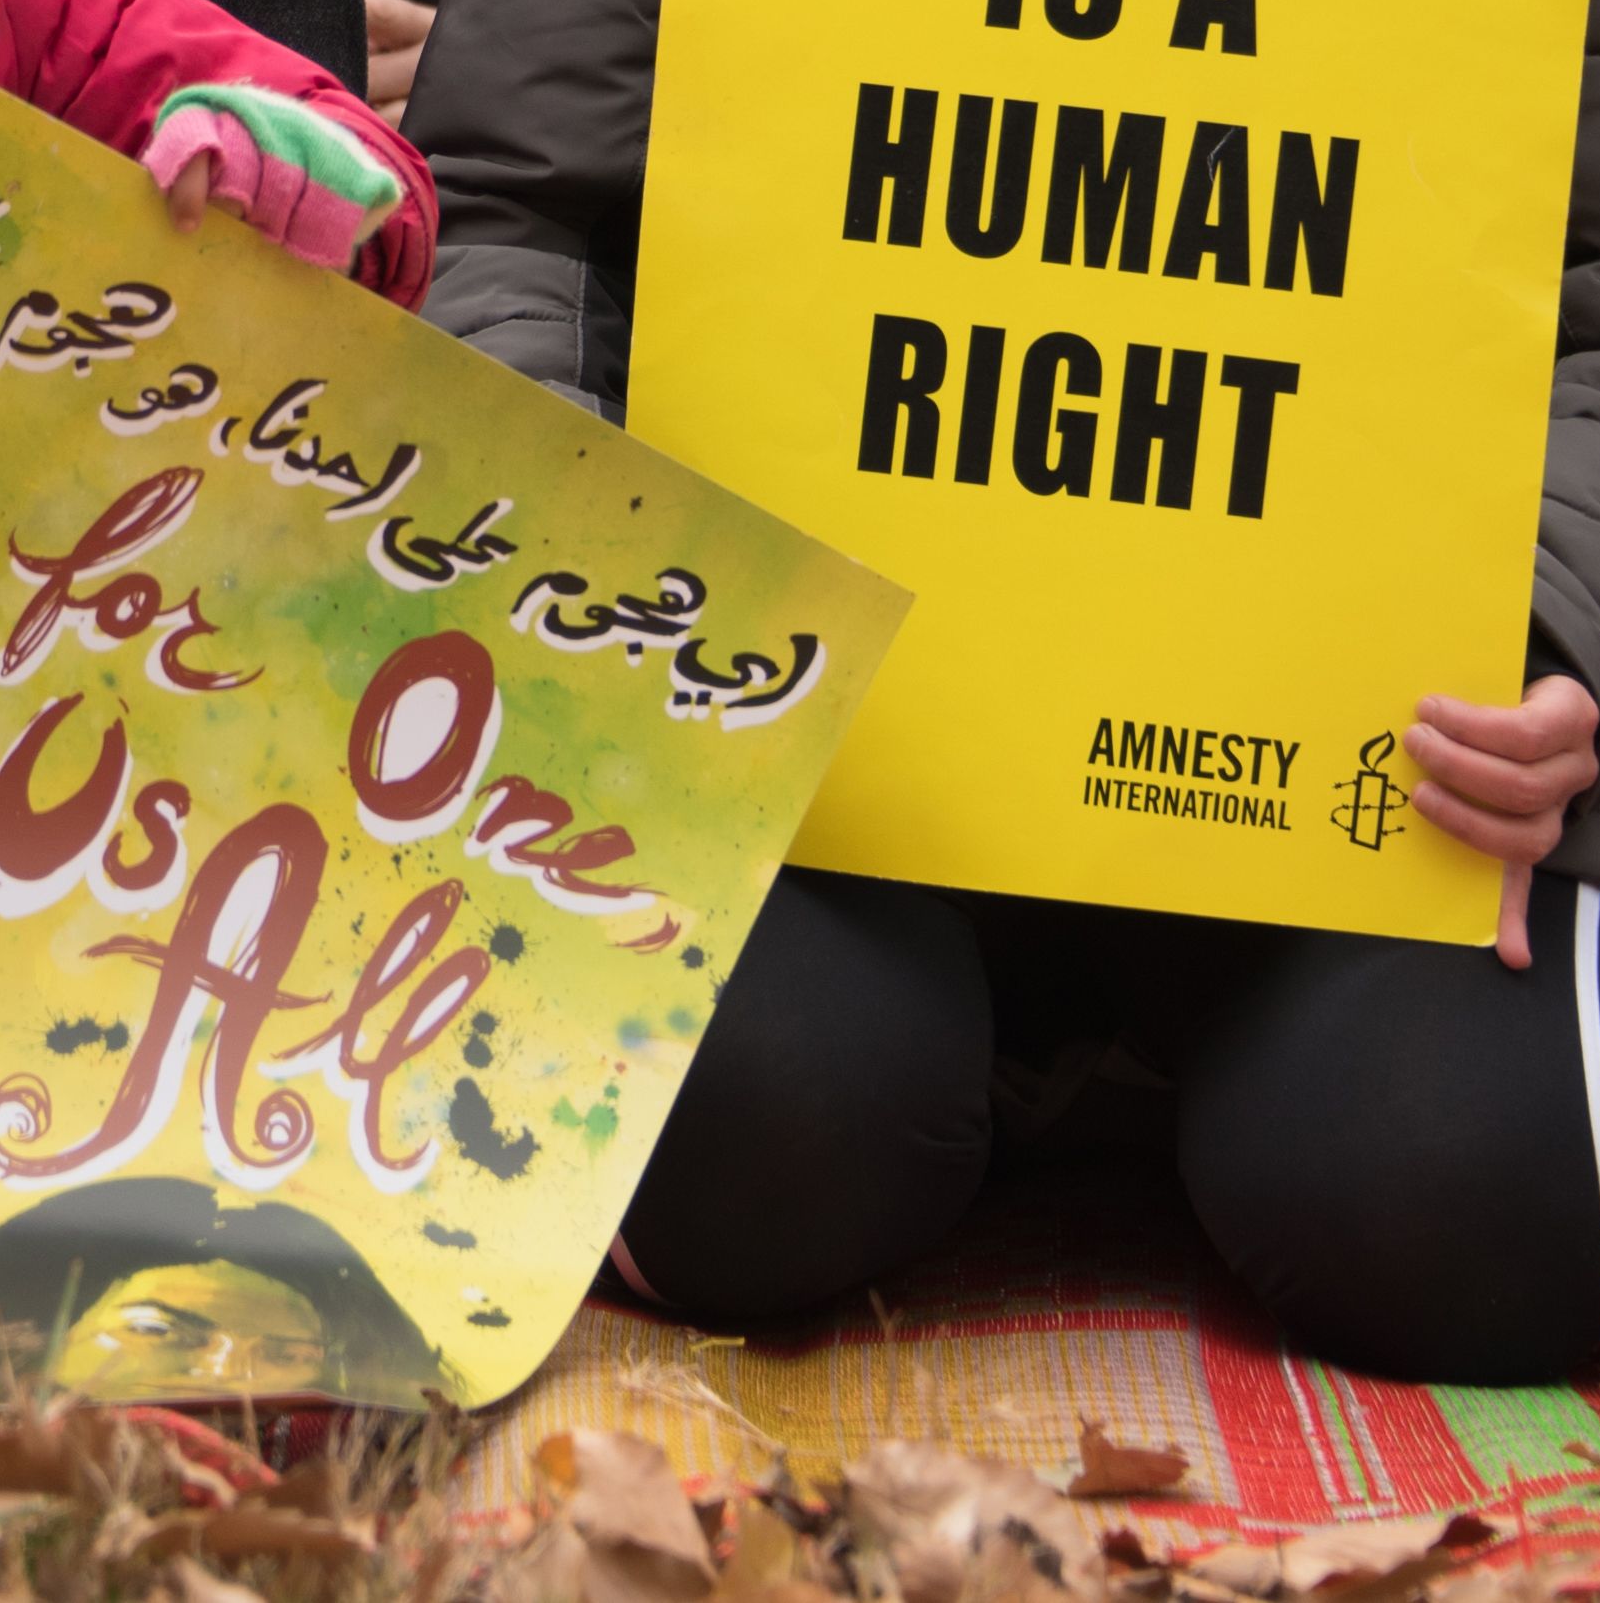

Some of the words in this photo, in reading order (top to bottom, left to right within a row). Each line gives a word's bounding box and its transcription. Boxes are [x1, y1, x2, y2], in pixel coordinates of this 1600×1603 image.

[841, 82, 1361, 298] HUMAN
[103, 362, 220, 429] هو
[856, 312, 1301, 519] RIGHT
[375, 498, 519, 587] على
[509, 566, 708, 661] هجوم
[1086, 716, 1302, 789] AMNESTY
[1082, 775, 1292, 831] INTERNATIONAL
